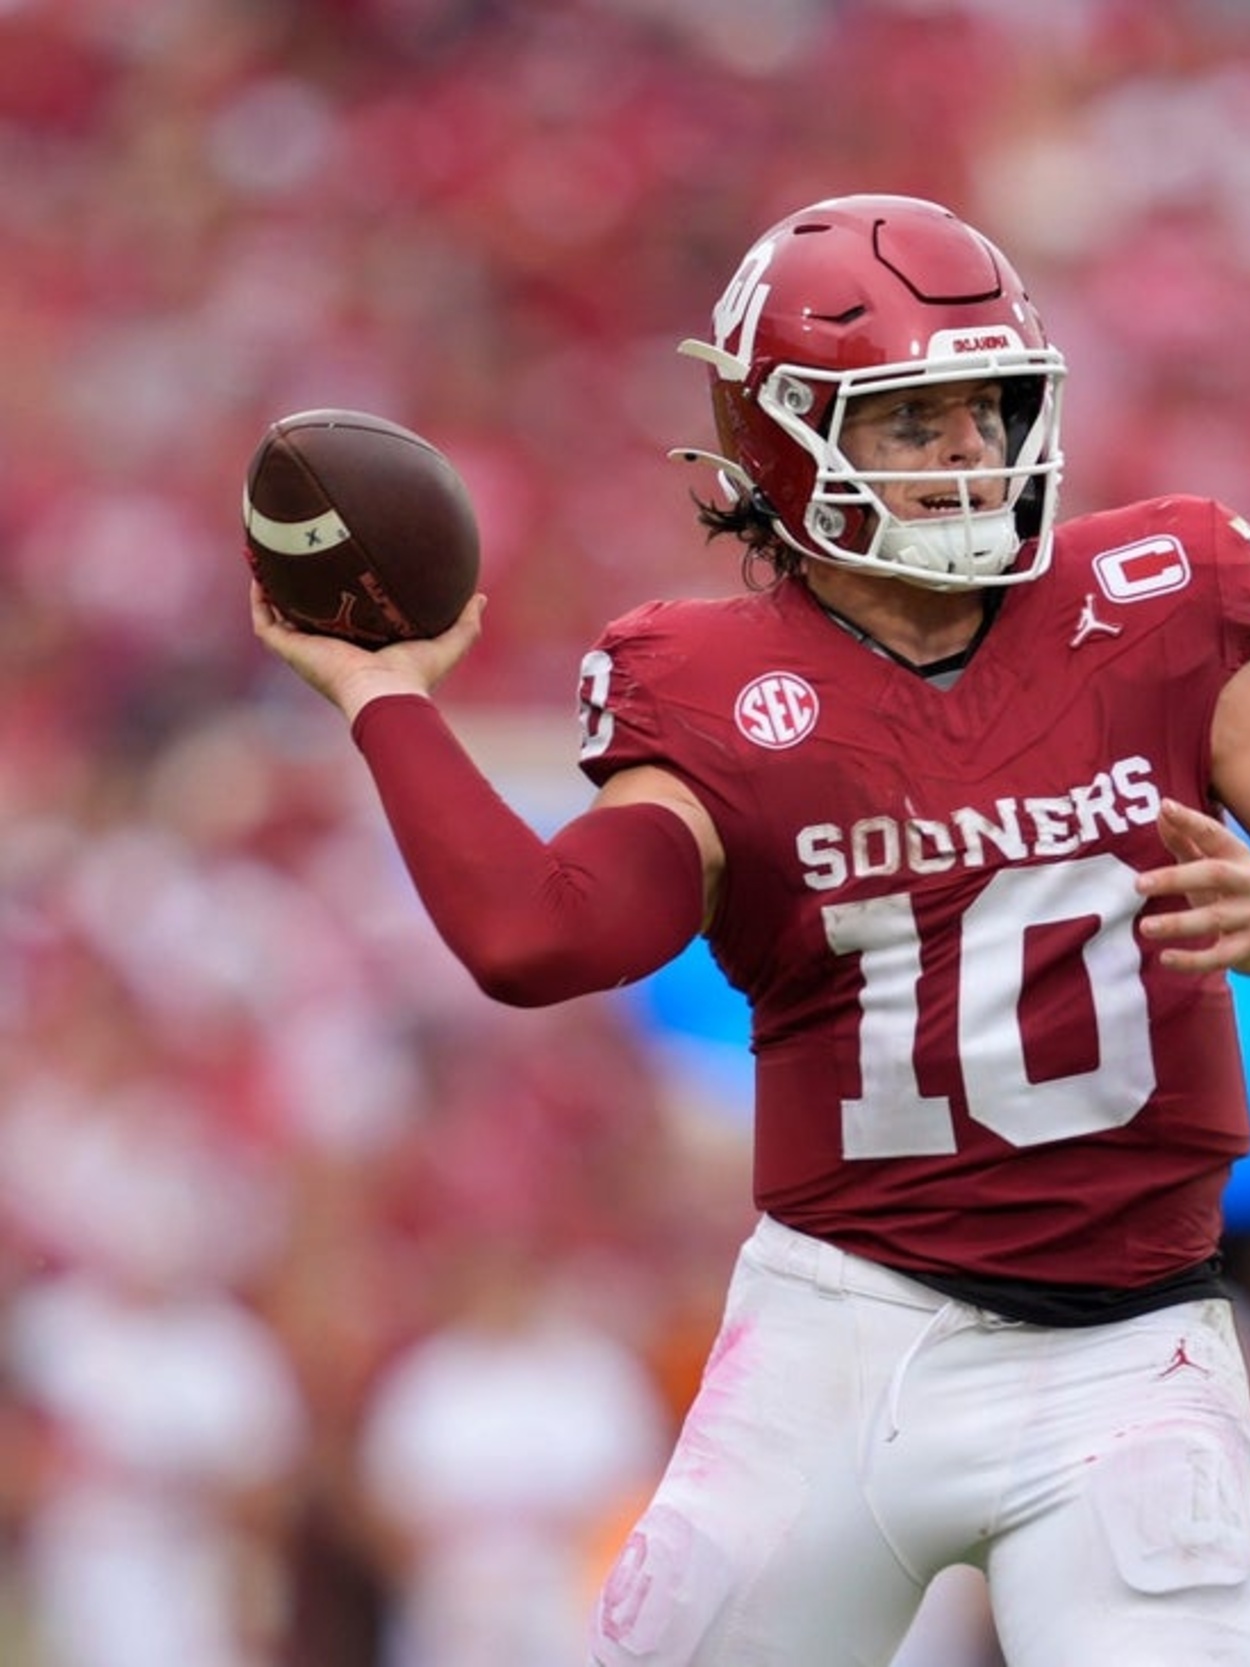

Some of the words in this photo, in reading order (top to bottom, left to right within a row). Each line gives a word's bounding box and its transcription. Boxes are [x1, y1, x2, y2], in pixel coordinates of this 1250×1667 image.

[1098, 539, 1185, 598] C
[741, 677, 813, 744] SEC
[796, 755, 1162, 890] SOONERS
[821, 852, 1157, 1160] 10
